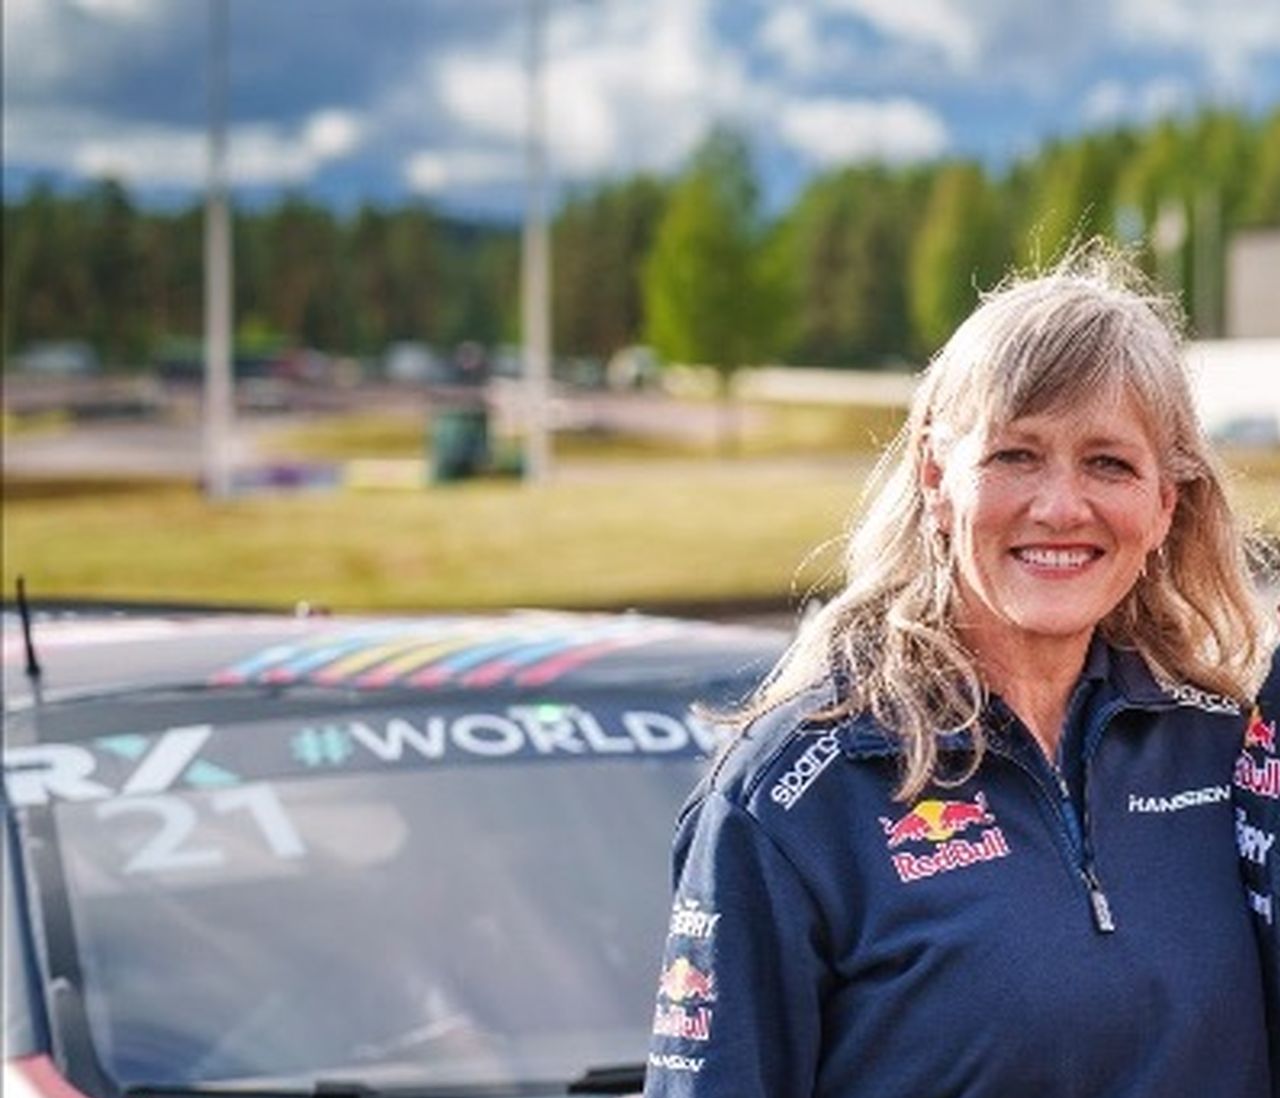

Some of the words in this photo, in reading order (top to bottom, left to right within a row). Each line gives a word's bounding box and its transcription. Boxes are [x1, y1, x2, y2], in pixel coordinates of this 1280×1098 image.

[2, 724, 242, 806] RX
[293, 703, 718, 766] #WORLD
[97, 782, 306, 874] 21
[1128, 785, 1231, 812] HANSEN
[891, 842, 955, 882] Red
[949, 826, 1010, 867] Bull
